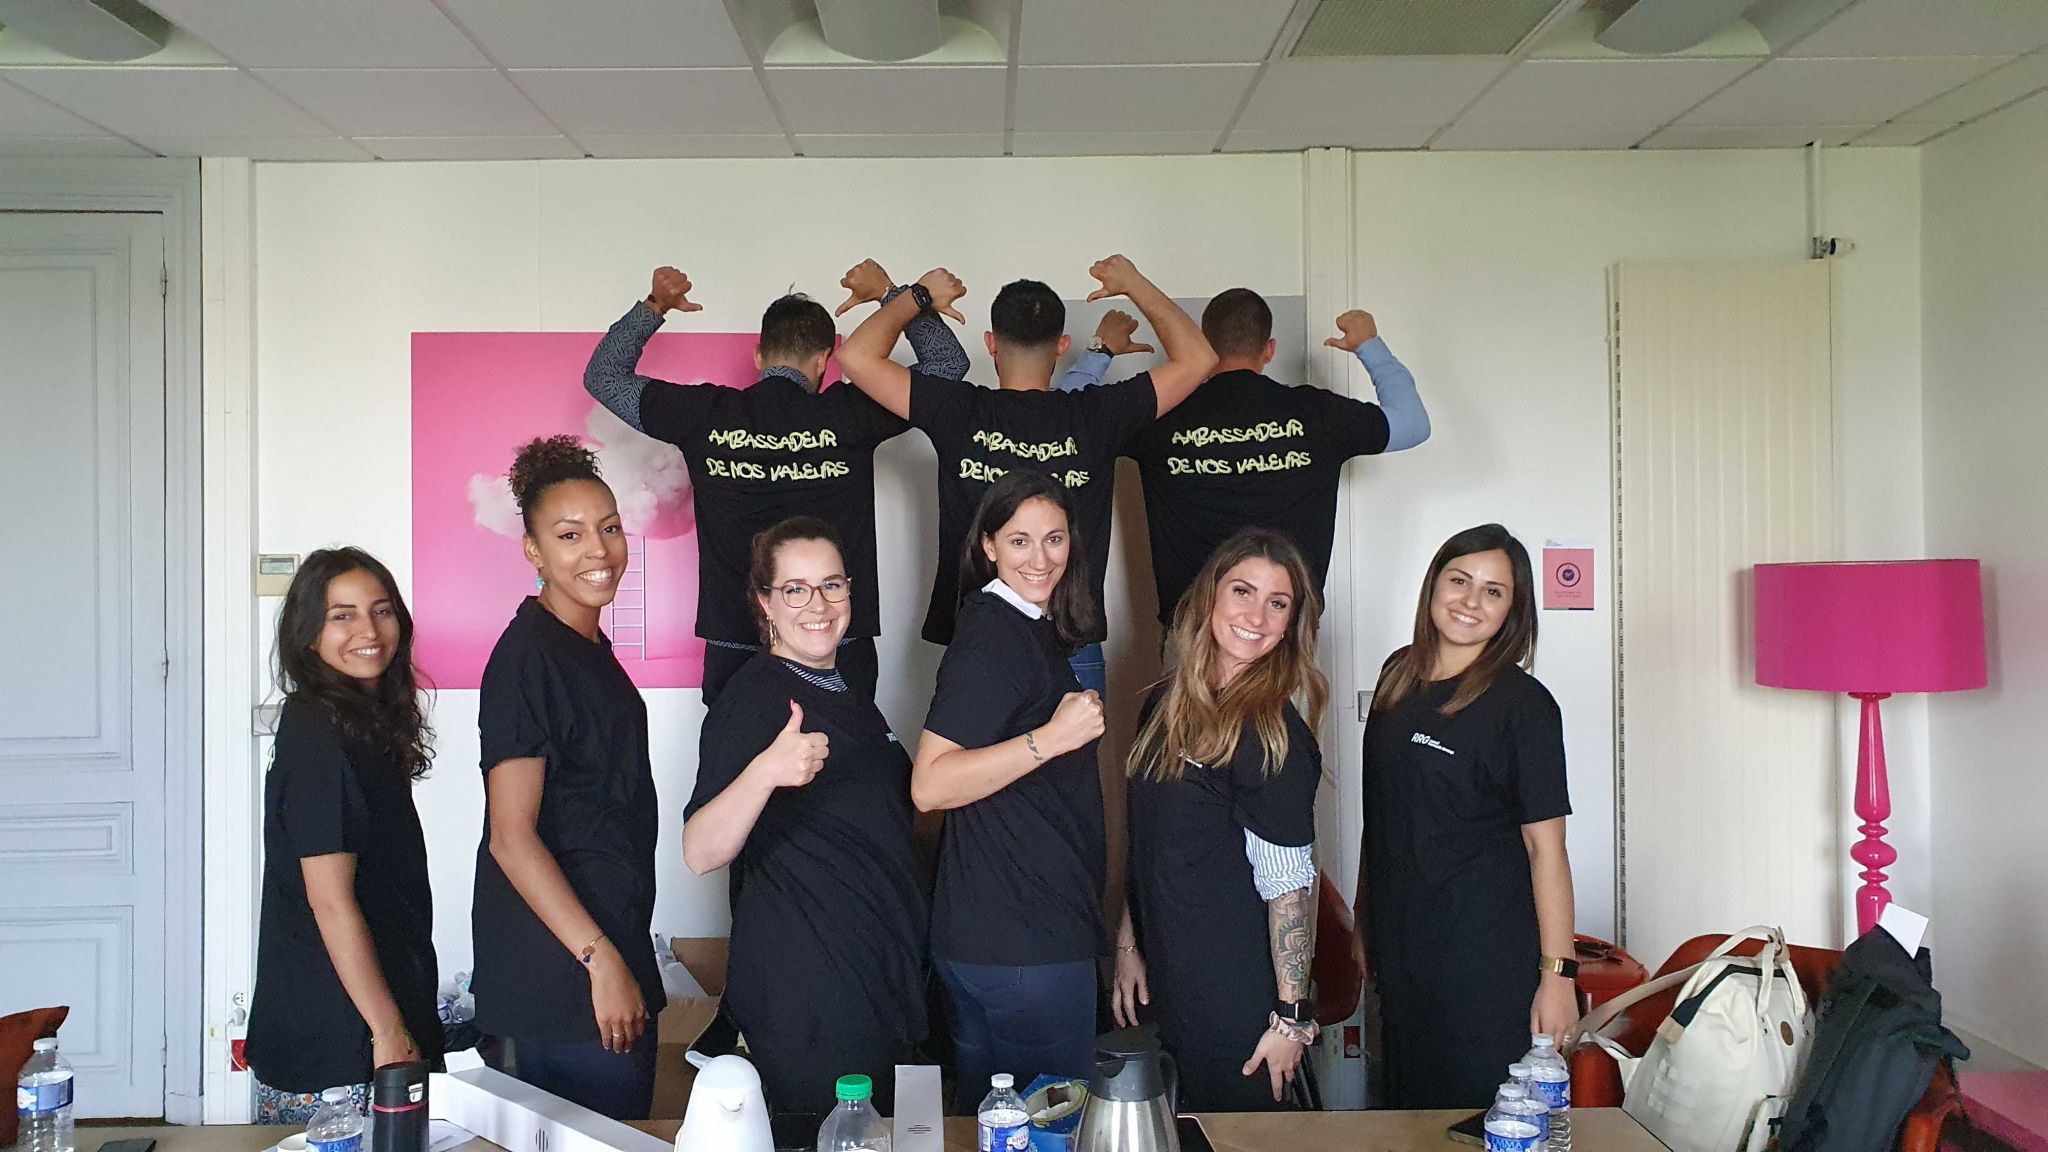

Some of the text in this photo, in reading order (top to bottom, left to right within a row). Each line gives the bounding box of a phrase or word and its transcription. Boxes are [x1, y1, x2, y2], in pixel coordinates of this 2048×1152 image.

[709, 429, 837, 452] AMBASSADEUR
[1172, 419, 1304, 447] AMBASSADEUR
[706, 457, 850, 481] DE NOS VALEURS
[959, 458, 1009, 483] DE NO
[1167, 451, 1311, 474] DE NOS VALEURS
